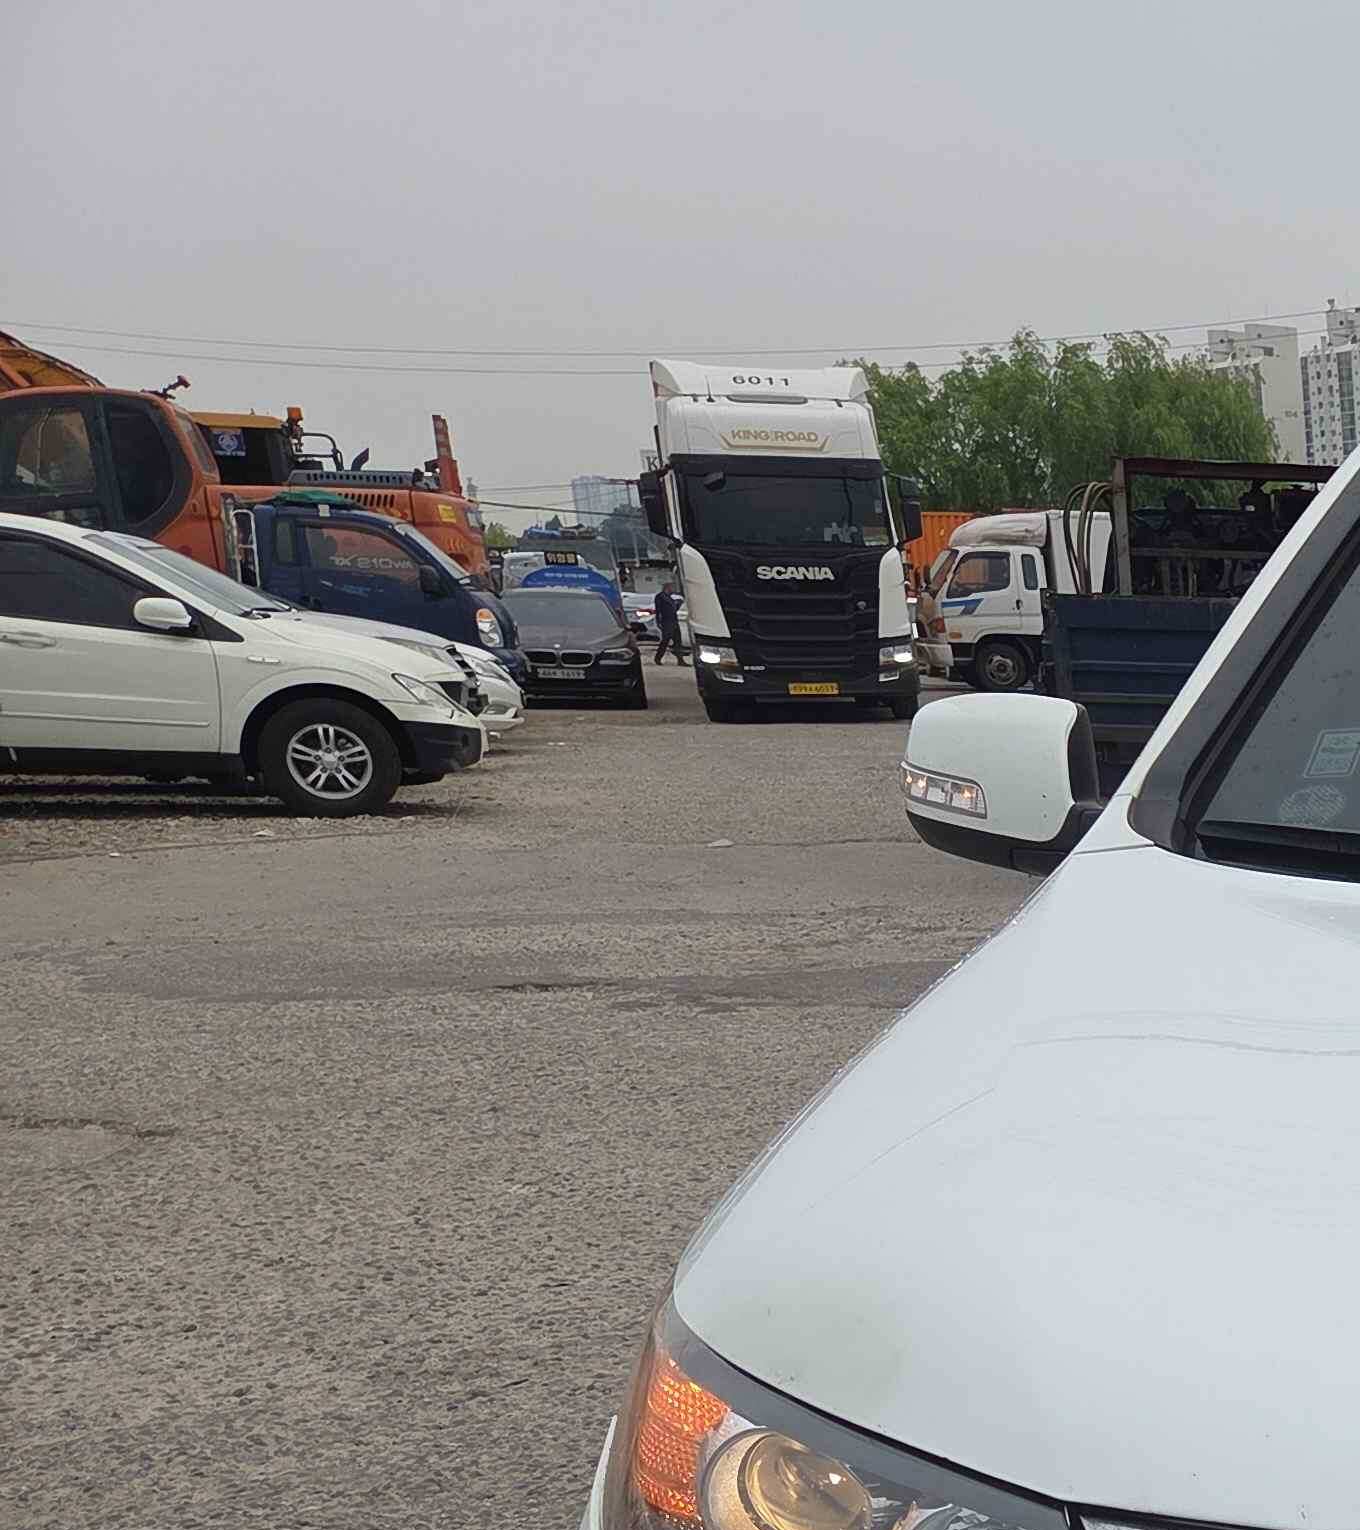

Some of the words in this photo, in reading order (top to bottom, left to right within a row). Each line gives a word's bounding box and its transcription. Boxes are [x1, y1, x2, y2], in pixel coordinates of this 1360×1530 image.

[732, 375, 789, 386] 6011
[731, 430, 769, 441] KING
[773, 431, 818, 442] ROAD
[756, 565, 835, 580] SCANIA
